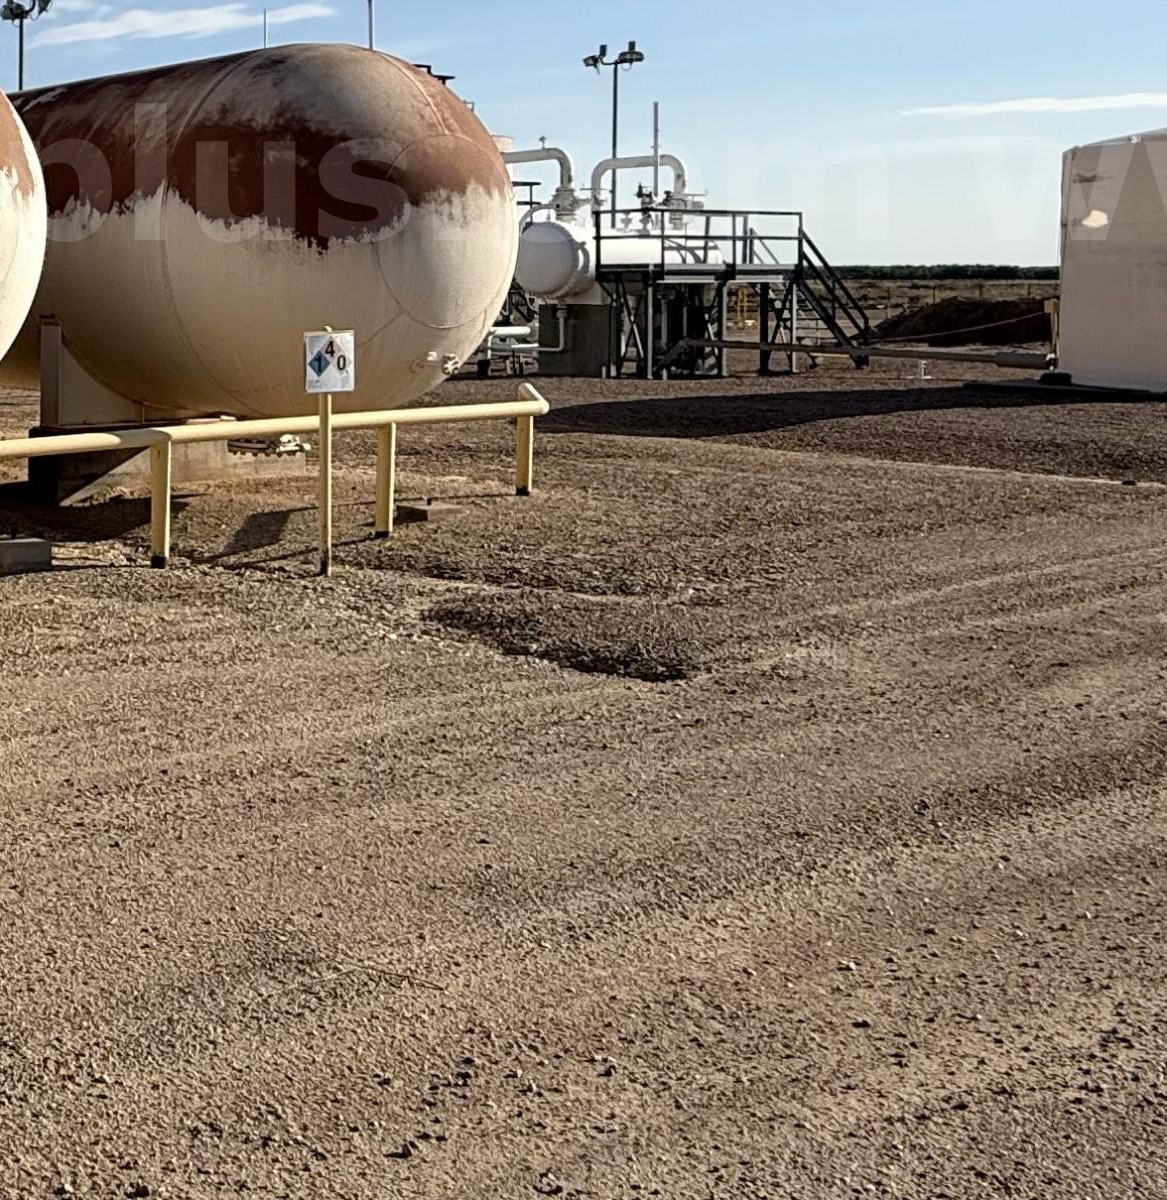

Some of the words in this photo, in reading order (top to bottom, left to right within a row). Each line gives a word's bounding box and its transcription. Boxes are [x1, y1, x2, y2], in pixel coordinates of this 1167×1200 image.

[325, 340, 335, 358] 4
[314, 356, 323, 373] 1
[337, 354, 346, 371] 0
